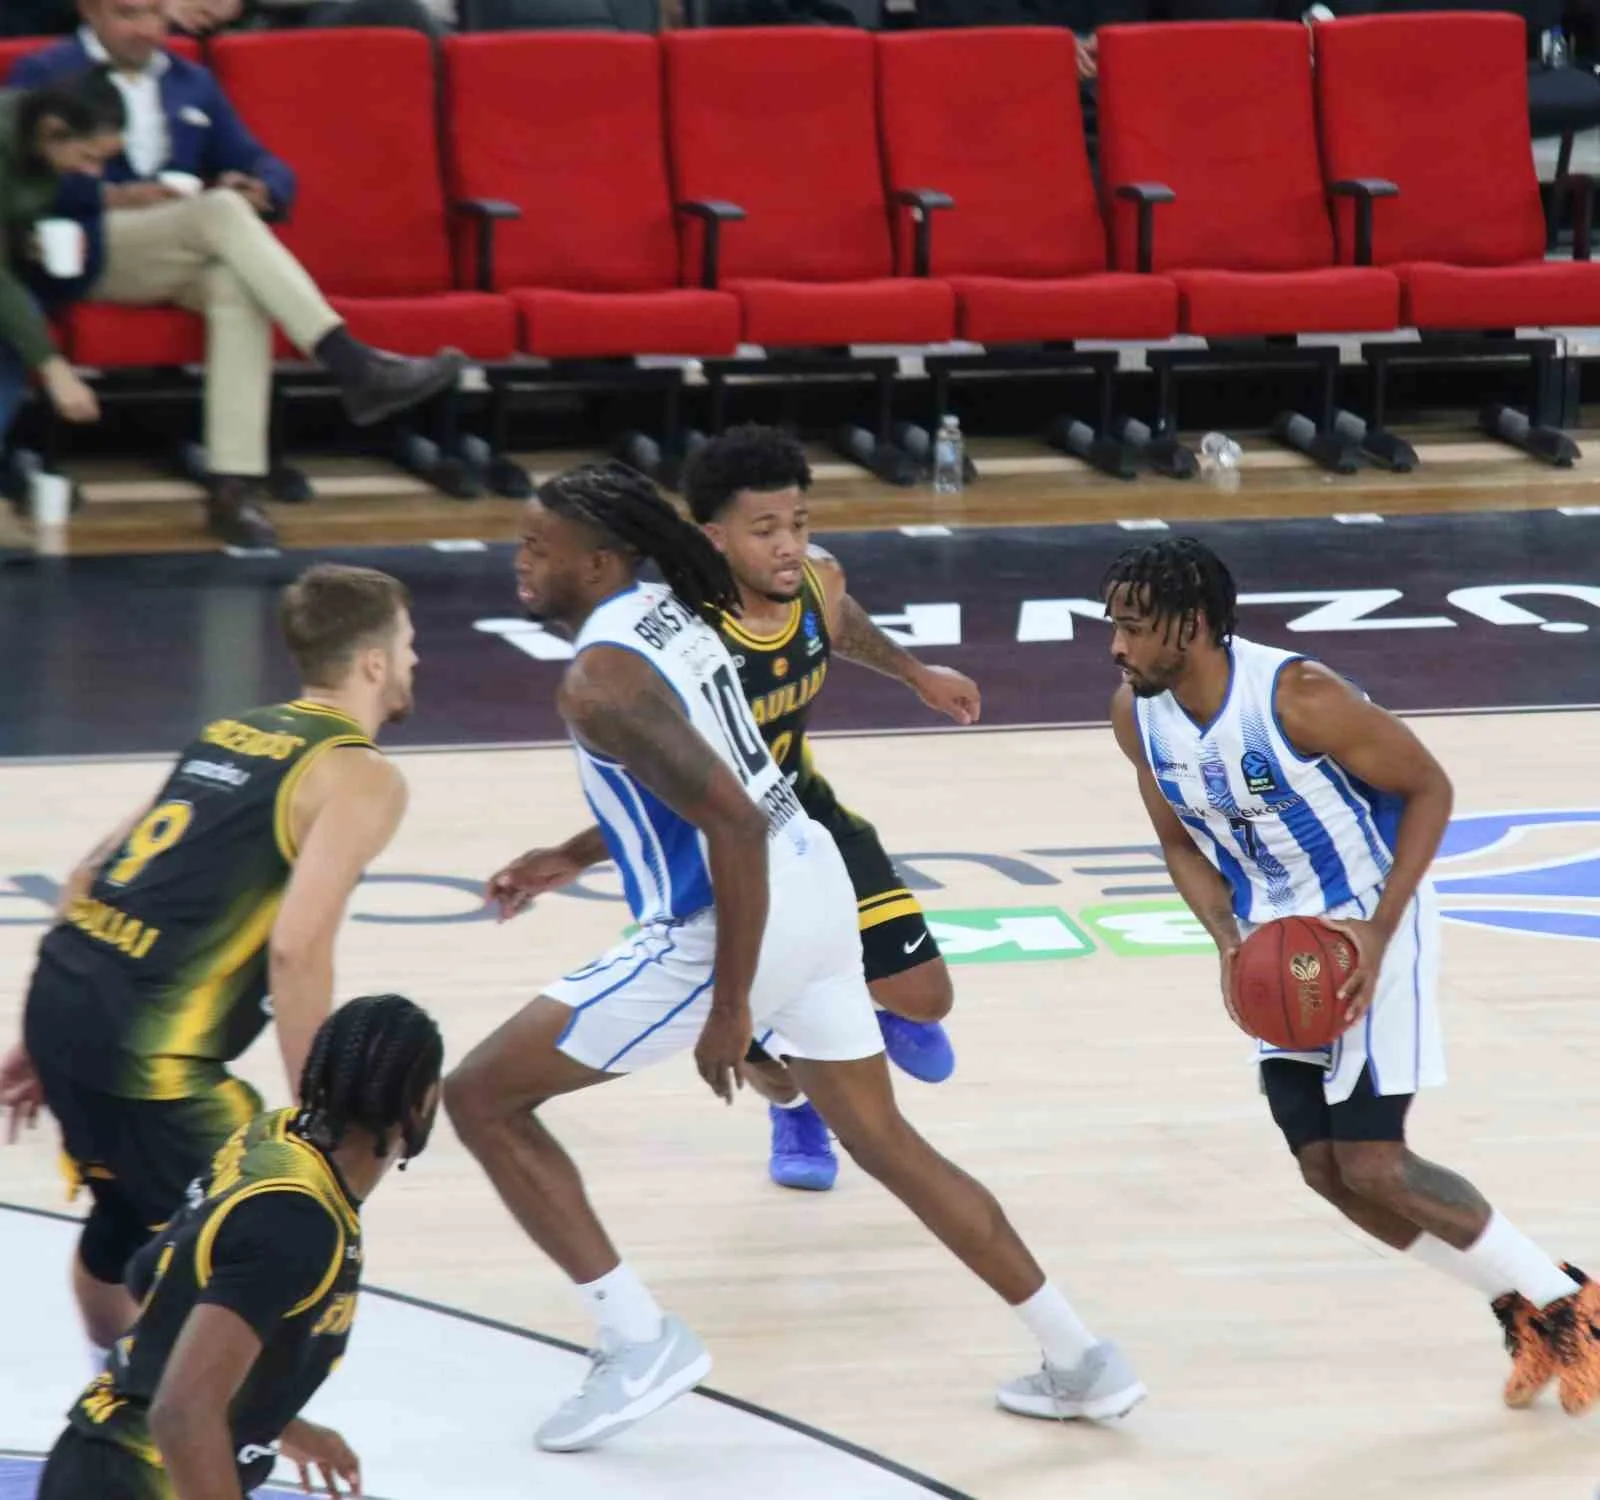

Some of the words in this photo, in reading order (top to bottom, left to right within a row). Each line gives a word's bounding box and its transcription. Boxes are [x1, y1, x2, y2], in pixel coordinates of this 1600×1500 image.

[700, 663, 769, 786] 10
[105, 800, 194, 888] 9
[1228, 817, 1257, 858] 7
